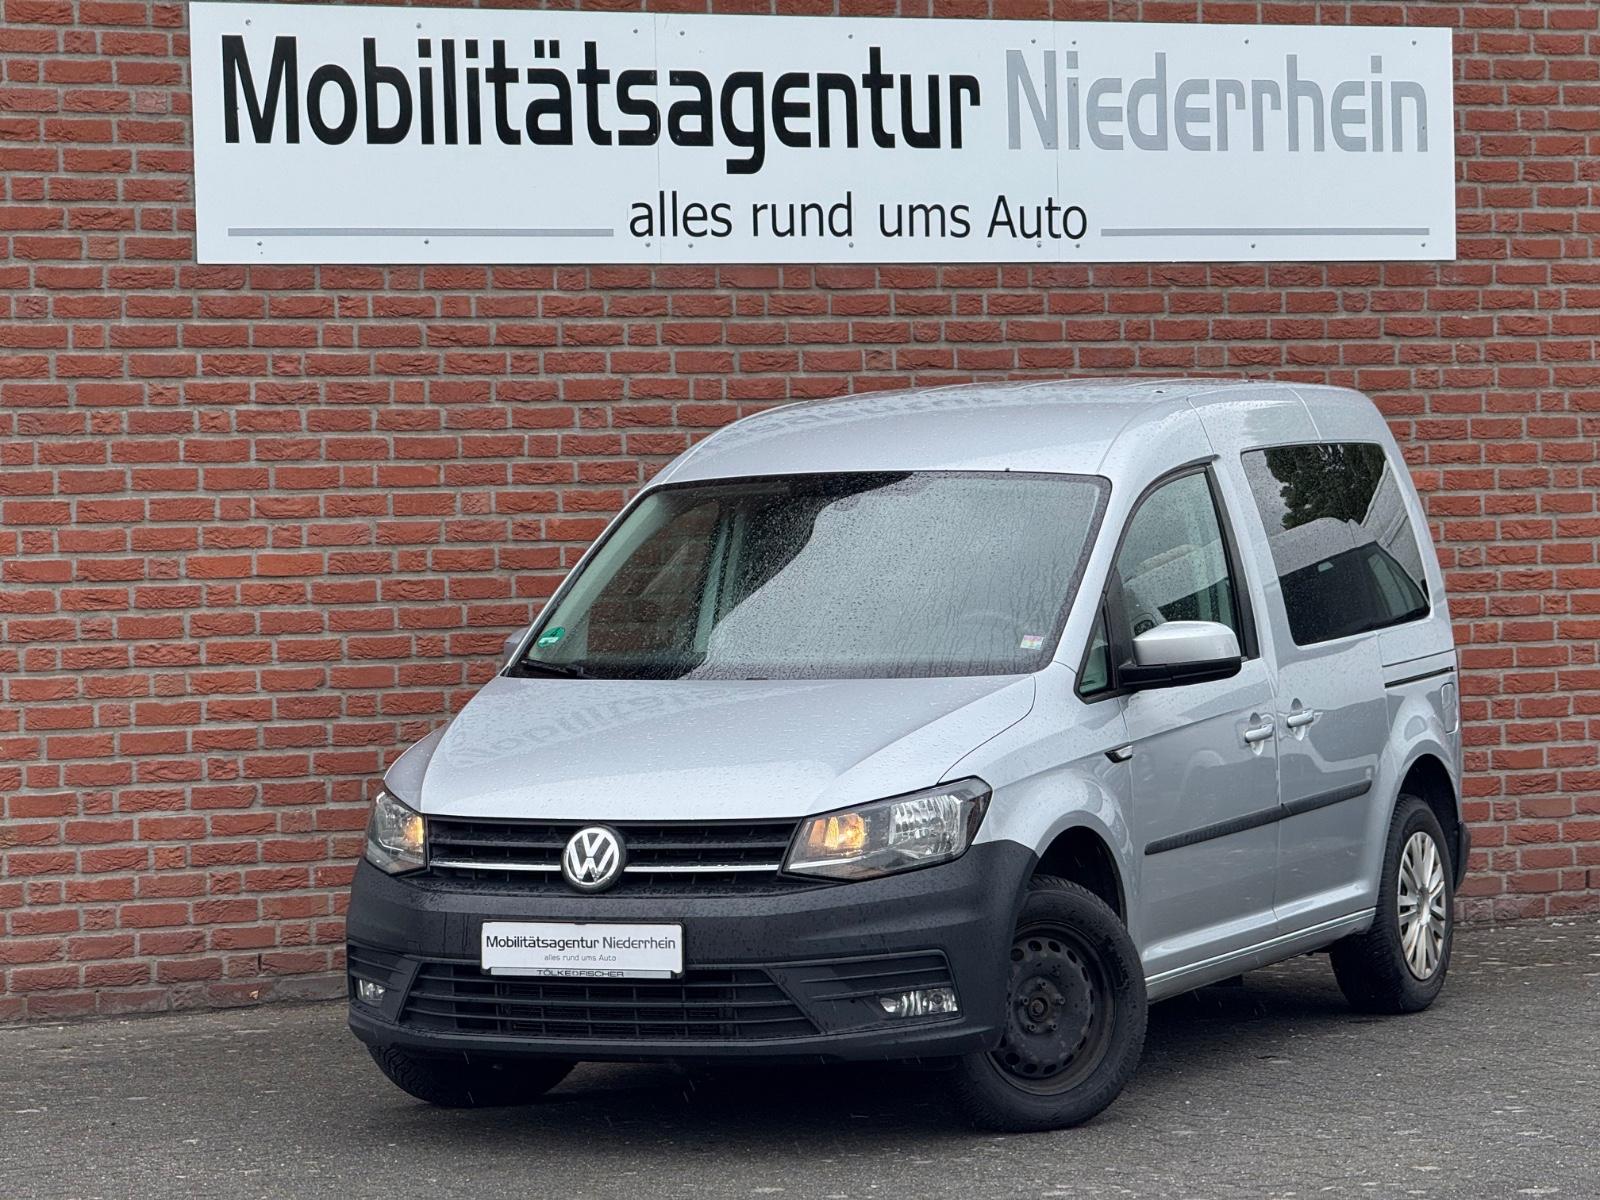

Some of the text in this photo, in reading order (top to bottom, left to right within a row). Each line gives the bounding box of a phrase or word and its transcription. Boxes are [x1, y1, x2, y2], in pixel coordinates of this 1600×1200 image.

[222, 35, 1428, 174] Mobilitätsagentur Niederrhein
[630, 191, 1087, 239] alles rund ums Auto
[486, 936, 675, 951] Mobilitätsagentur Niederrhein
[562, 954, 579, 962] rund
[598, 954, 616, 962] Auto
